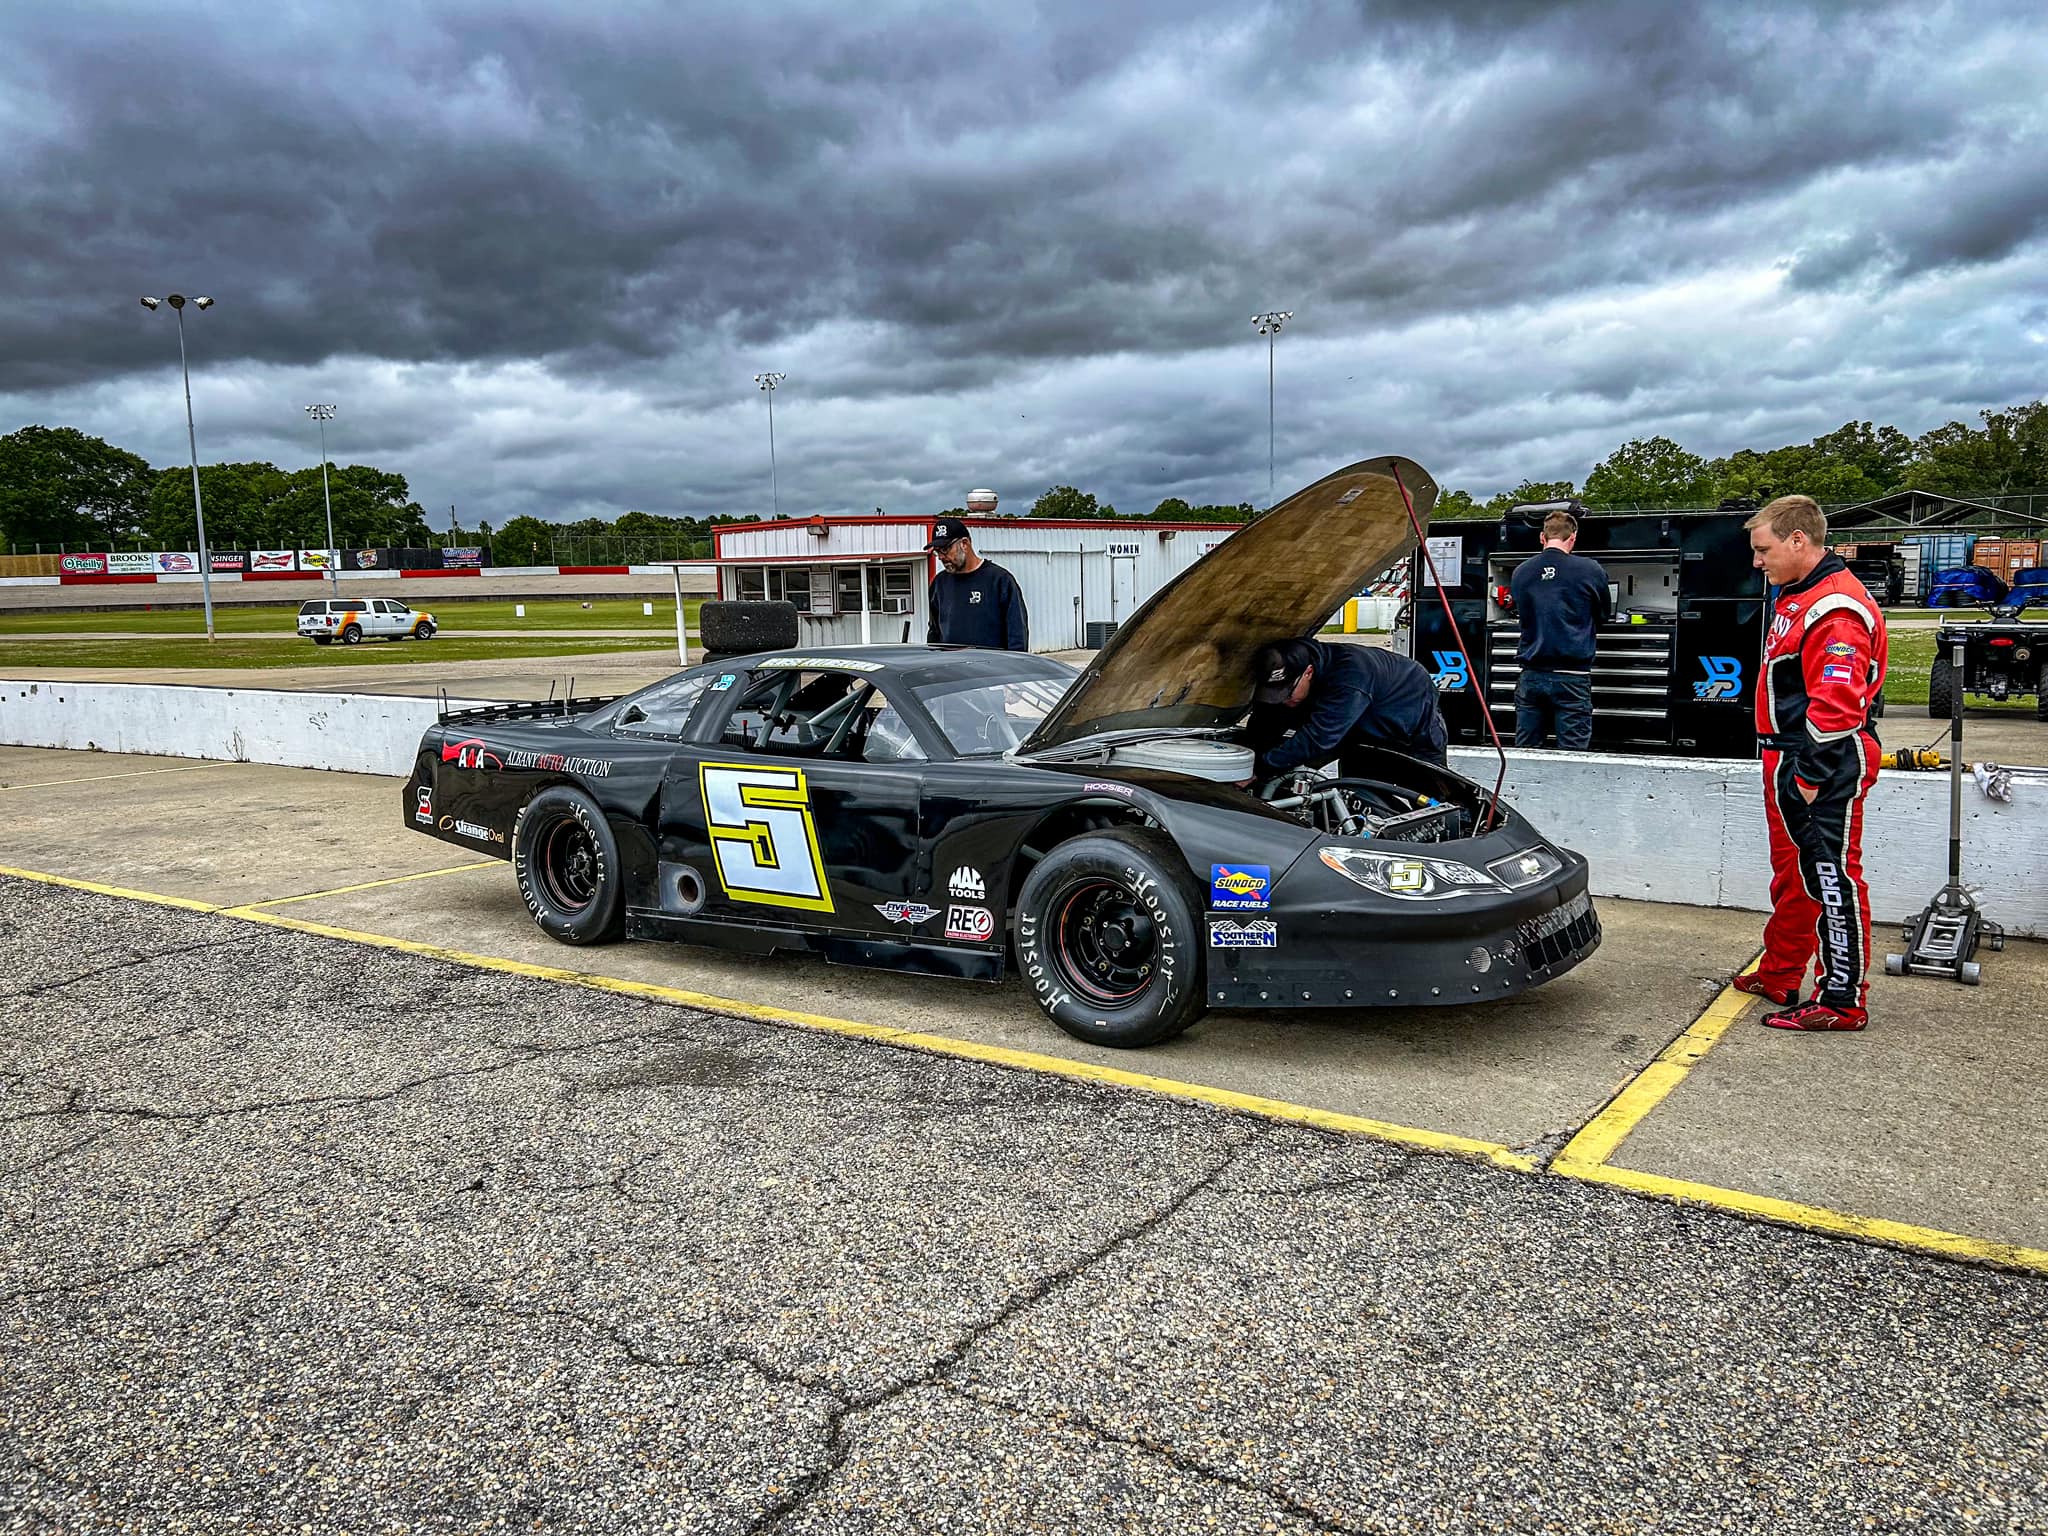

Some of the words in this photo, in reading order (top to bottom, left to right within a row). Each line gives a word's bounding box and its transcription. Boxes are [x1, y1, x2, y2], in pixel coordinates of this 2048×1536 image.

[1109, 544, 1140, 554] WOMEN
[63, 557, 103, 570] O'Reilly
[458, 748, 484, 769] AAA
[505, 751, 540, 768] ALBANY
[537, 753, 564, 771] AUTO
[561, 757, 612, 777] AUCTION
[1083, 783, 1134, 797] HOOSIER
[455, 819, 489, 841] Strange
[699, 762, 836, 914] 5
[948, 866, 985, 890] MAC
[1216, 878, 1265, 889] SUNOCO
[1390, 861, 1424, 890] 5
[948, 888, 986, 900] TOOLS
[887, 903, 906, 911] FIVE
[1212, 900, 1240, 908] RACE
[1239, 900, 1270, 909] FUELS
[1816, 862, 1850, 991] RUTHERFORD
[1212, 931, 1275, 946] SOUTHERN
[1020, 912, 1071, 1014] Hoosier
